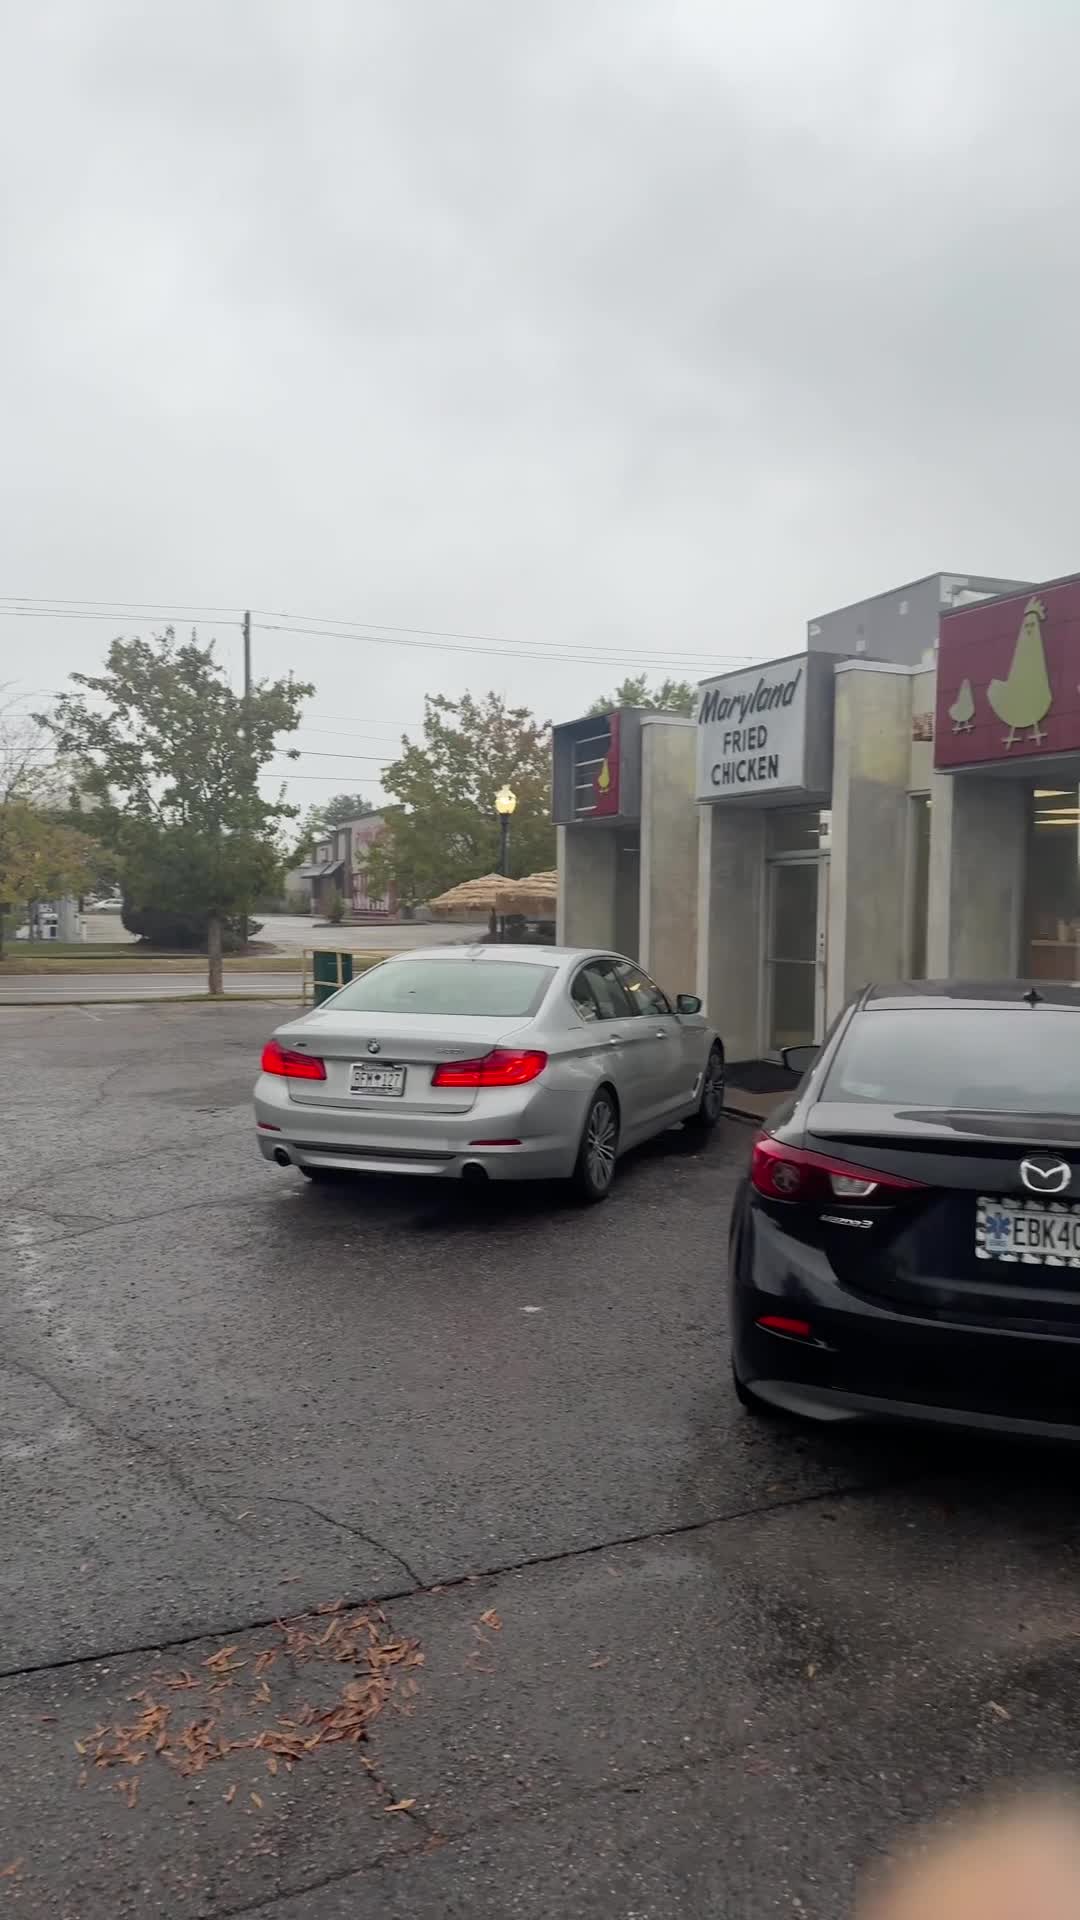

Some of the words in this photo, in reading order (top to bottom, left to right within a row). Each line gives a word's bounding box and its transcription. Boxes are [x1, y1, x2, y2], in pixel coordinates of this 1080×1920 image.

[699, 668, 802, 725] Maryland
[723, 725, 768, 754] FRIED
[711, 754, 779, 785] CHICKEN
